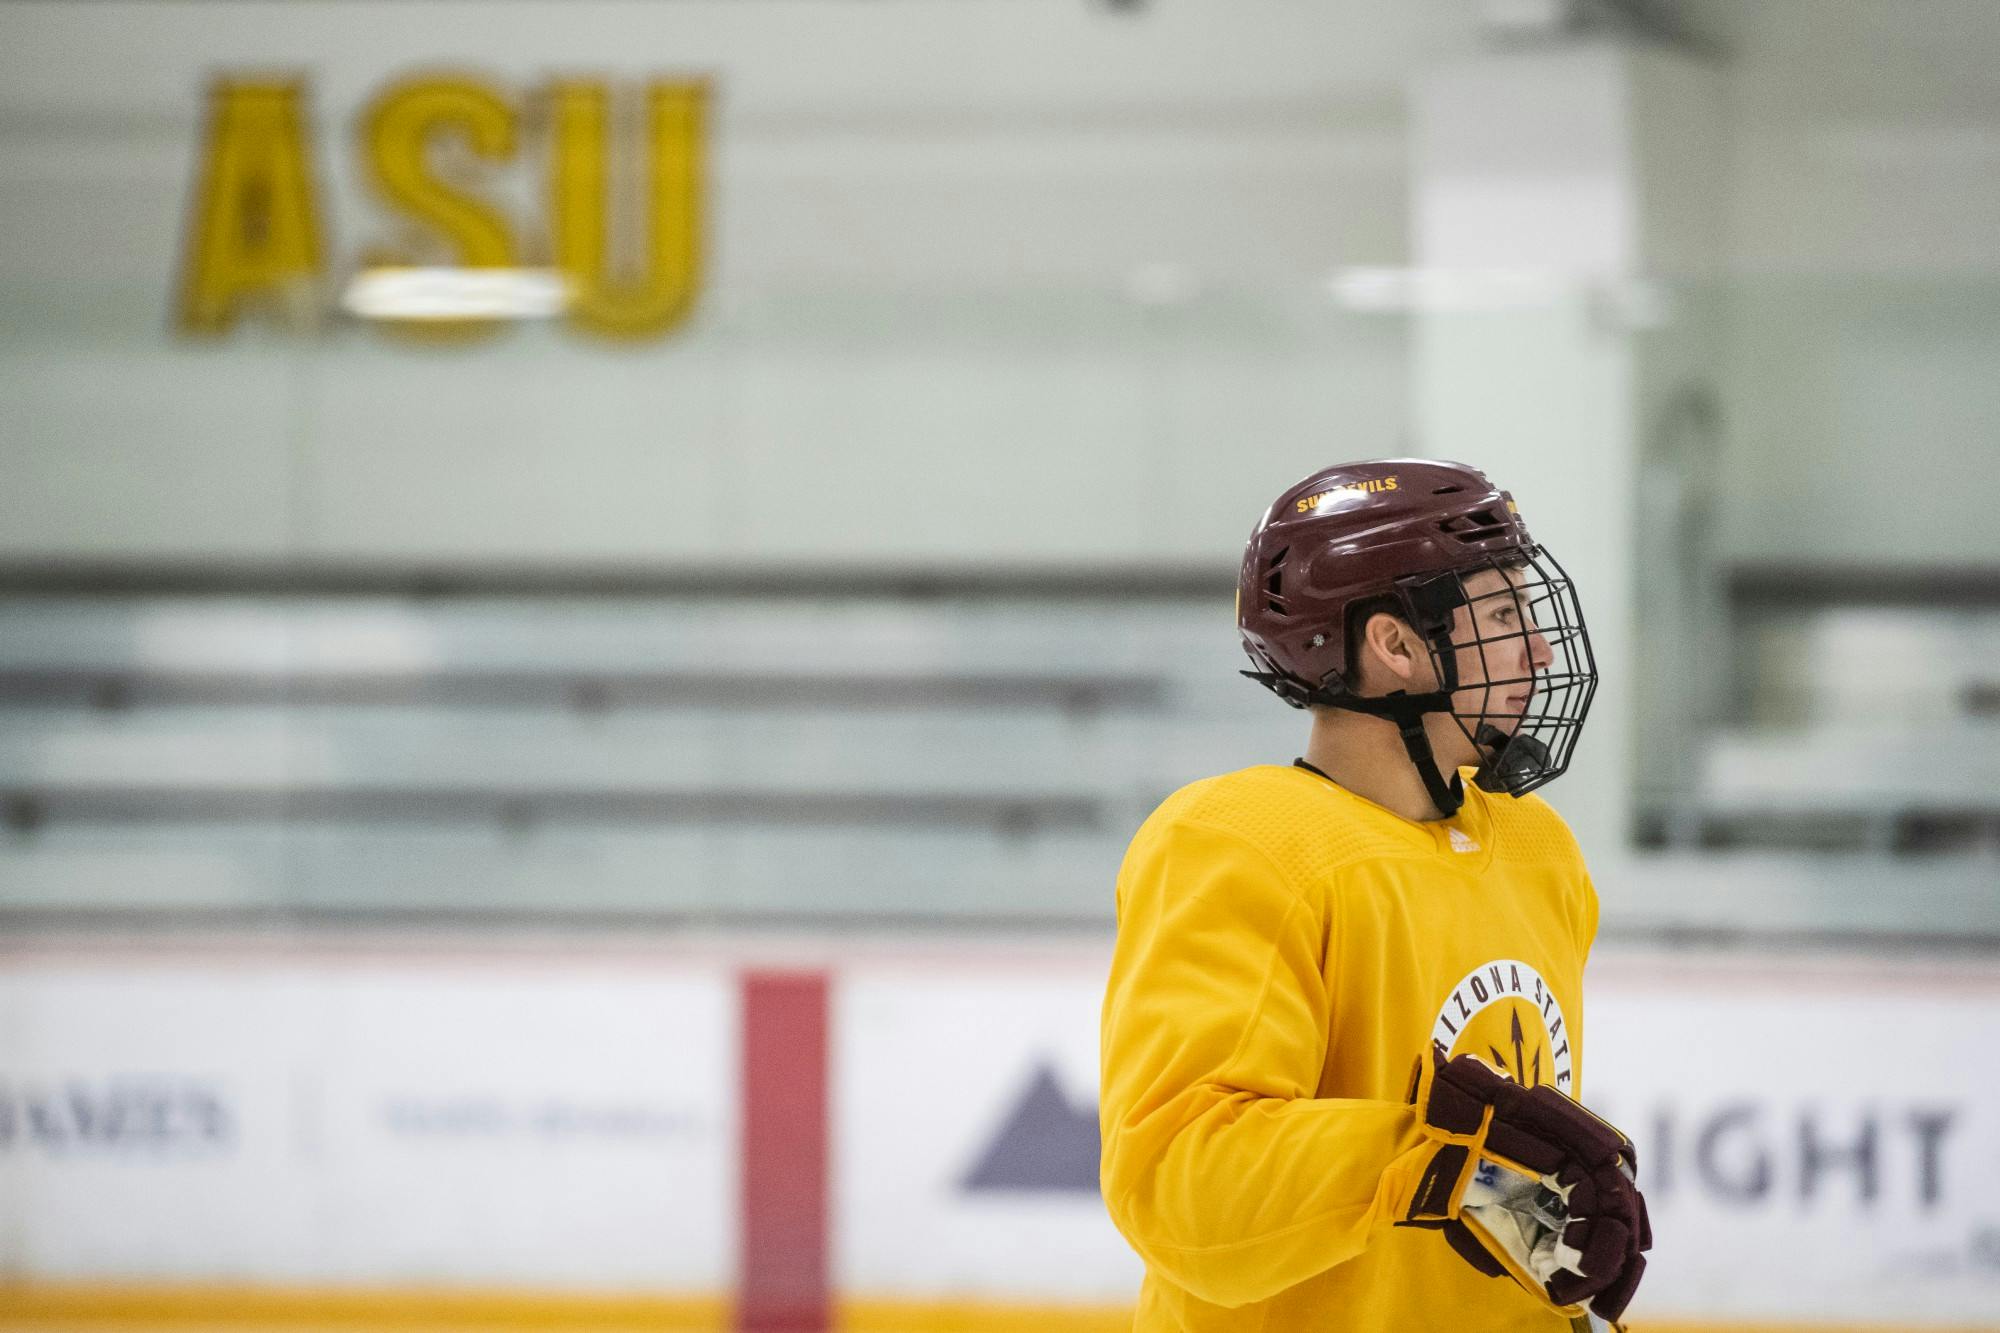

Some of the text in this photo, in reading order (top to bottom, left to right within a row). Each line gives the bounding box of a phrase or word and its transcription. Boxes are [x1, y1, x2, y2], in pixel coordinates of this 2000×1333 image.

[172, 68, 714, 342] ASU
[1296, 491, 1331, 513] SU
[1535, 977, 1571, 1087] STATE
